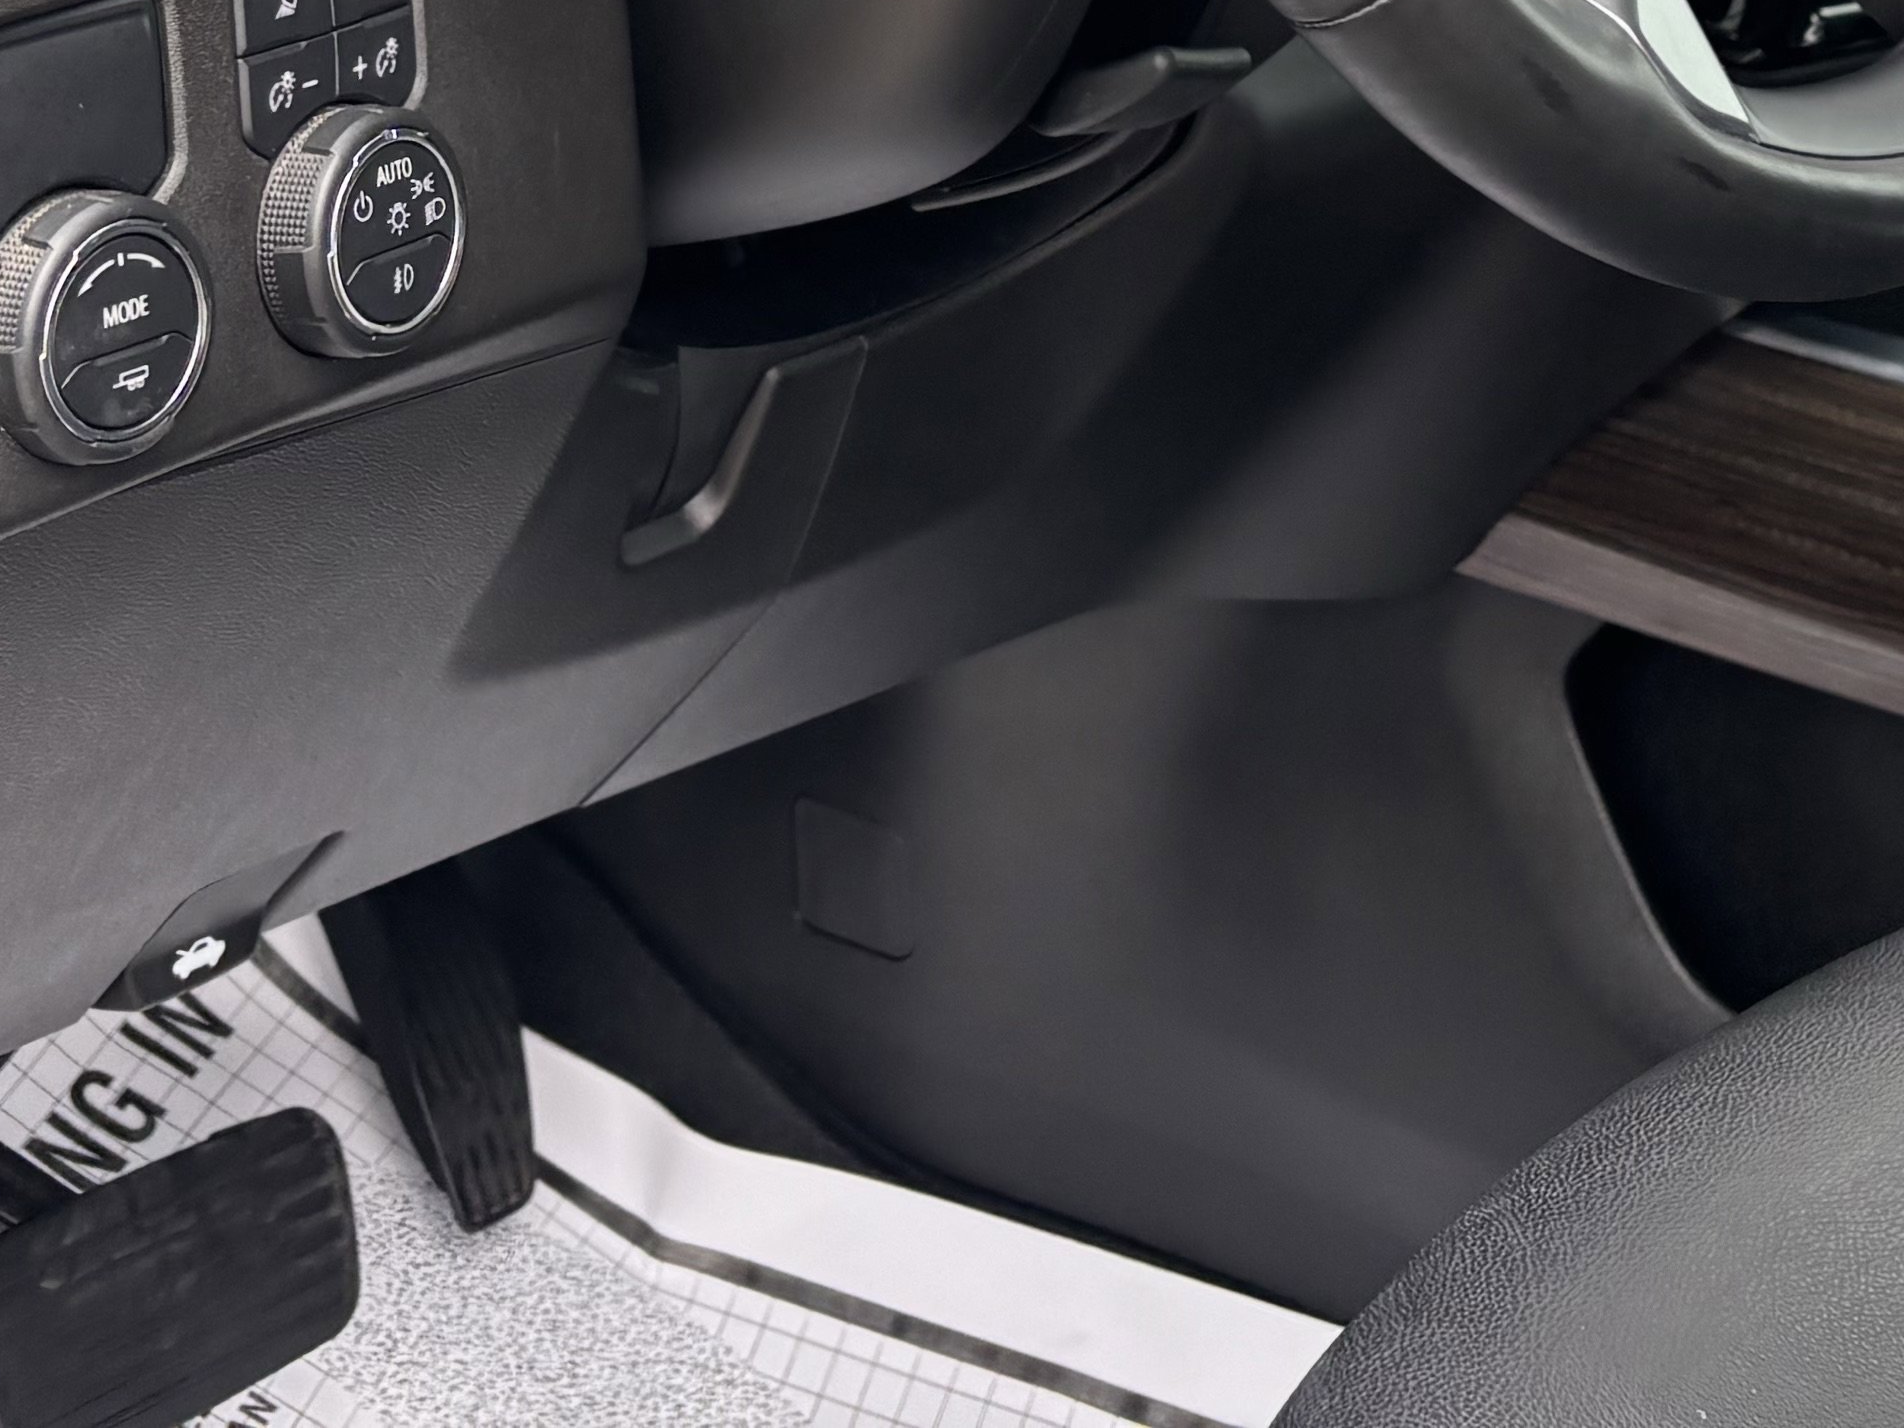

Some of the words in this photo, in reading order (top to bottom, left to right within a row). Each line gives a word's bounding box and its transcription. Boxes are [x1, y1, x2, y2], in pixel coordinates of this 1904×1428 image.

[376, 156, 413, 188] AUTO
[102, 294, 151, 329] MODE
[119, 990, 234, 1079] IN
